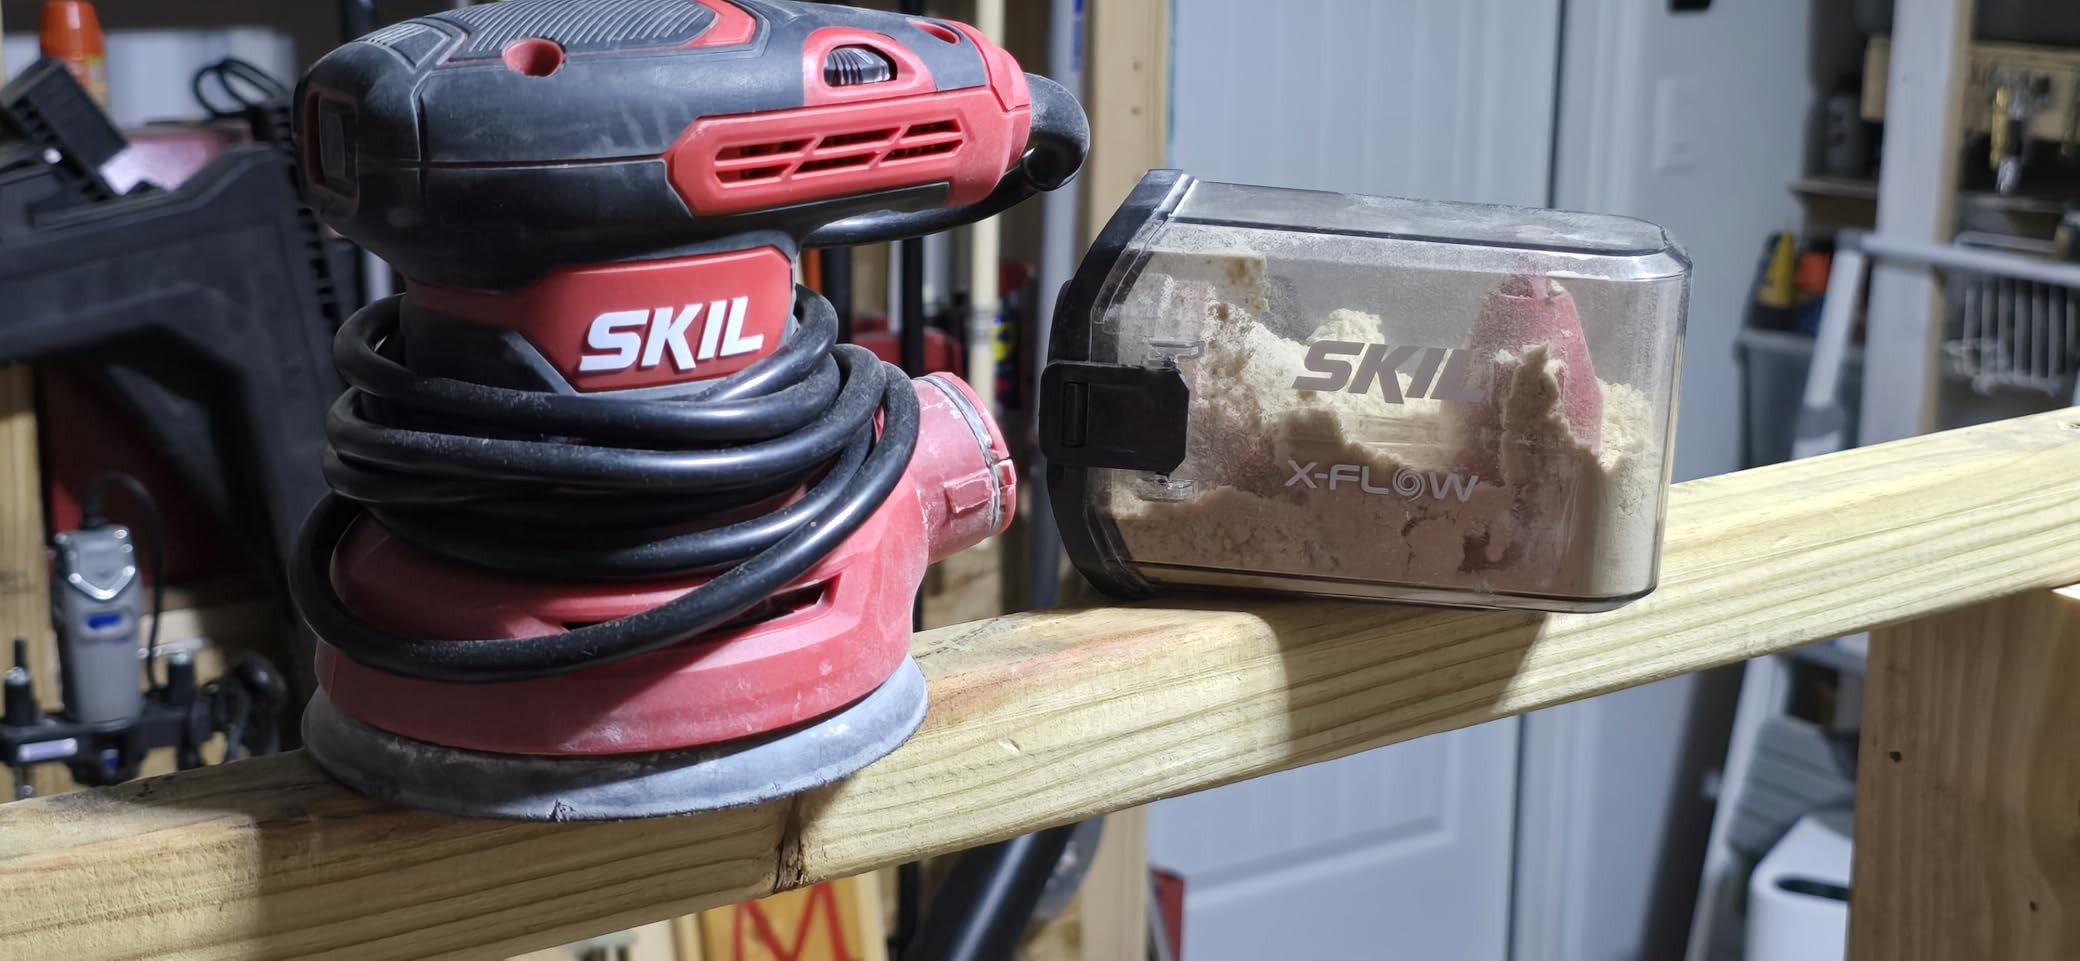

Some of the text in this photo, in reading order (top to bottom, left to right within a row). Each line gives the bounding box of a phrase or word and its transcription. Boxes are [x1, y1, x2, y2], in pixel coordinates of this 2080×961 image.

[579, 296, 765, 372] SKIL
[1292, 340, 1488, 405] SKIL
[1284, 459, 1480, 503] X-FLOW
